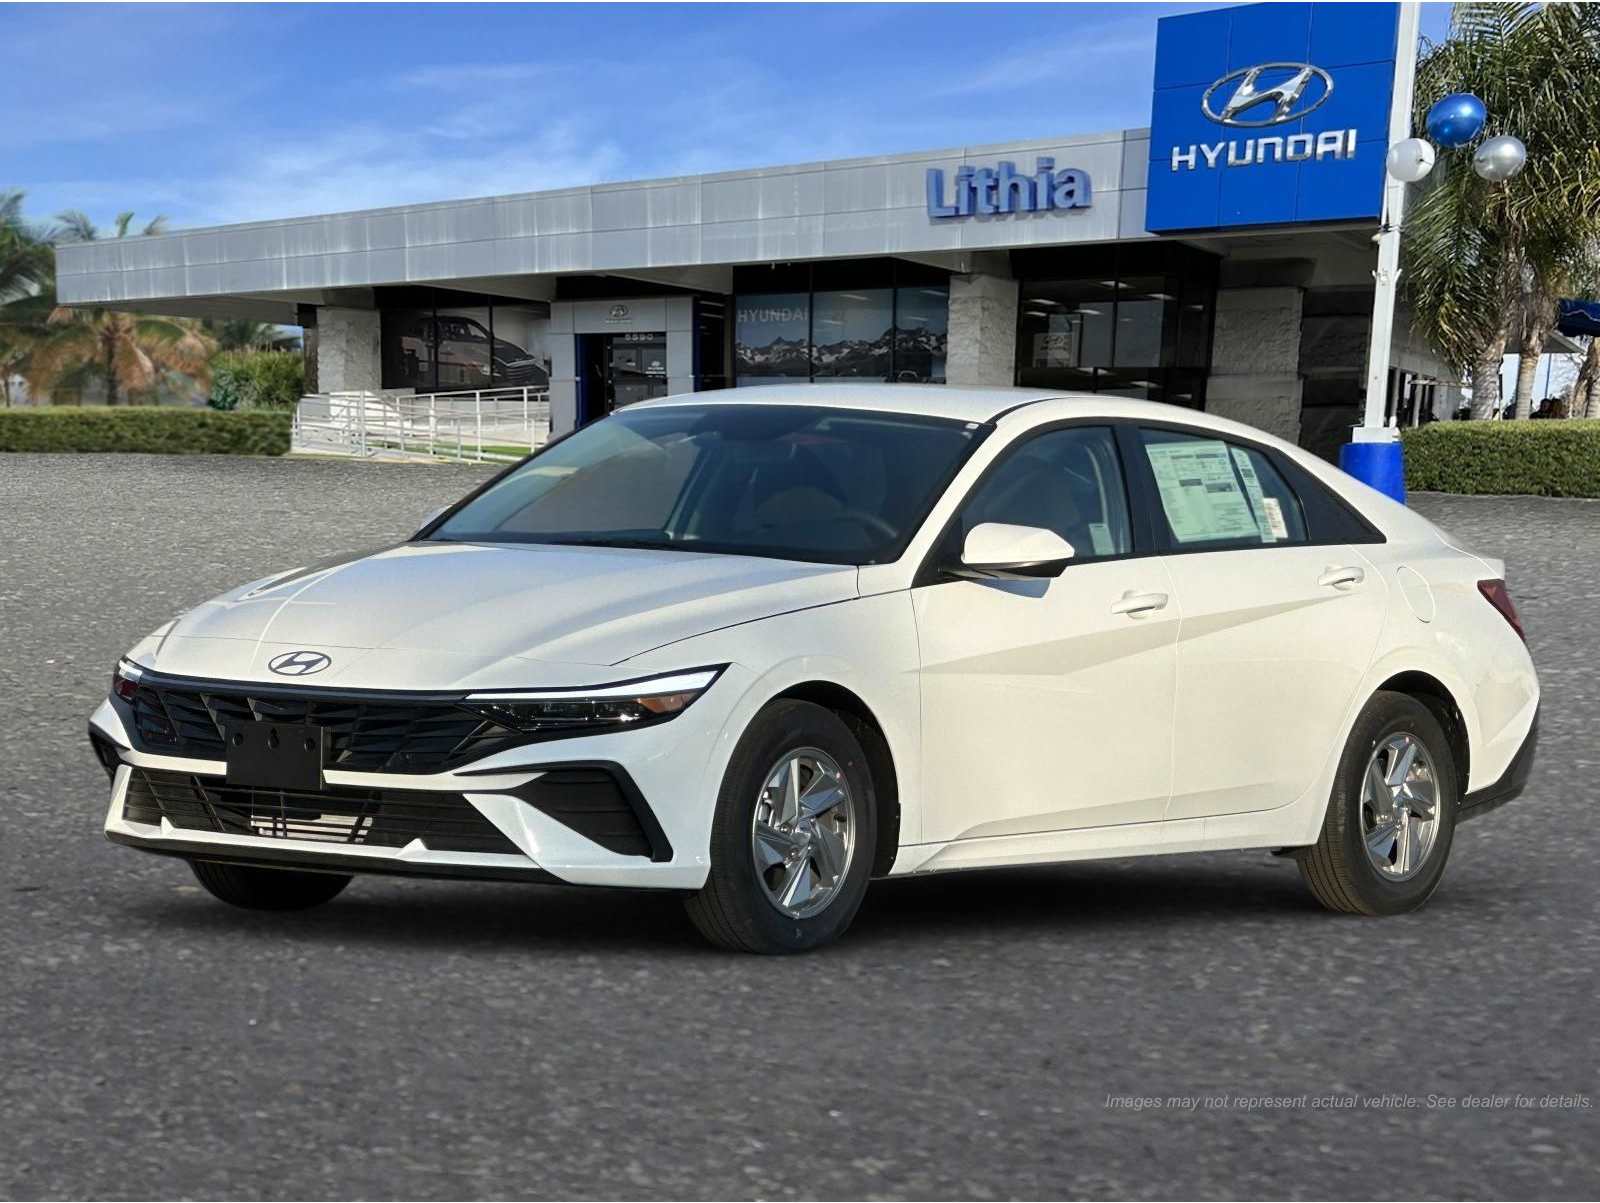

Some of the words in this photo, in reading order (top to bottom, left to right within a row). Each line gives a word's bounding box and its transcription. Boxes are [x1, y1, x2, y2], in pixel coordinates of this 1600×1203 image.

[1171, 129, 1356, 171] HYUNDAI
[926, 157, 1092, 218] Lithia
[737, 308, 808, 323] HYUNDAI
